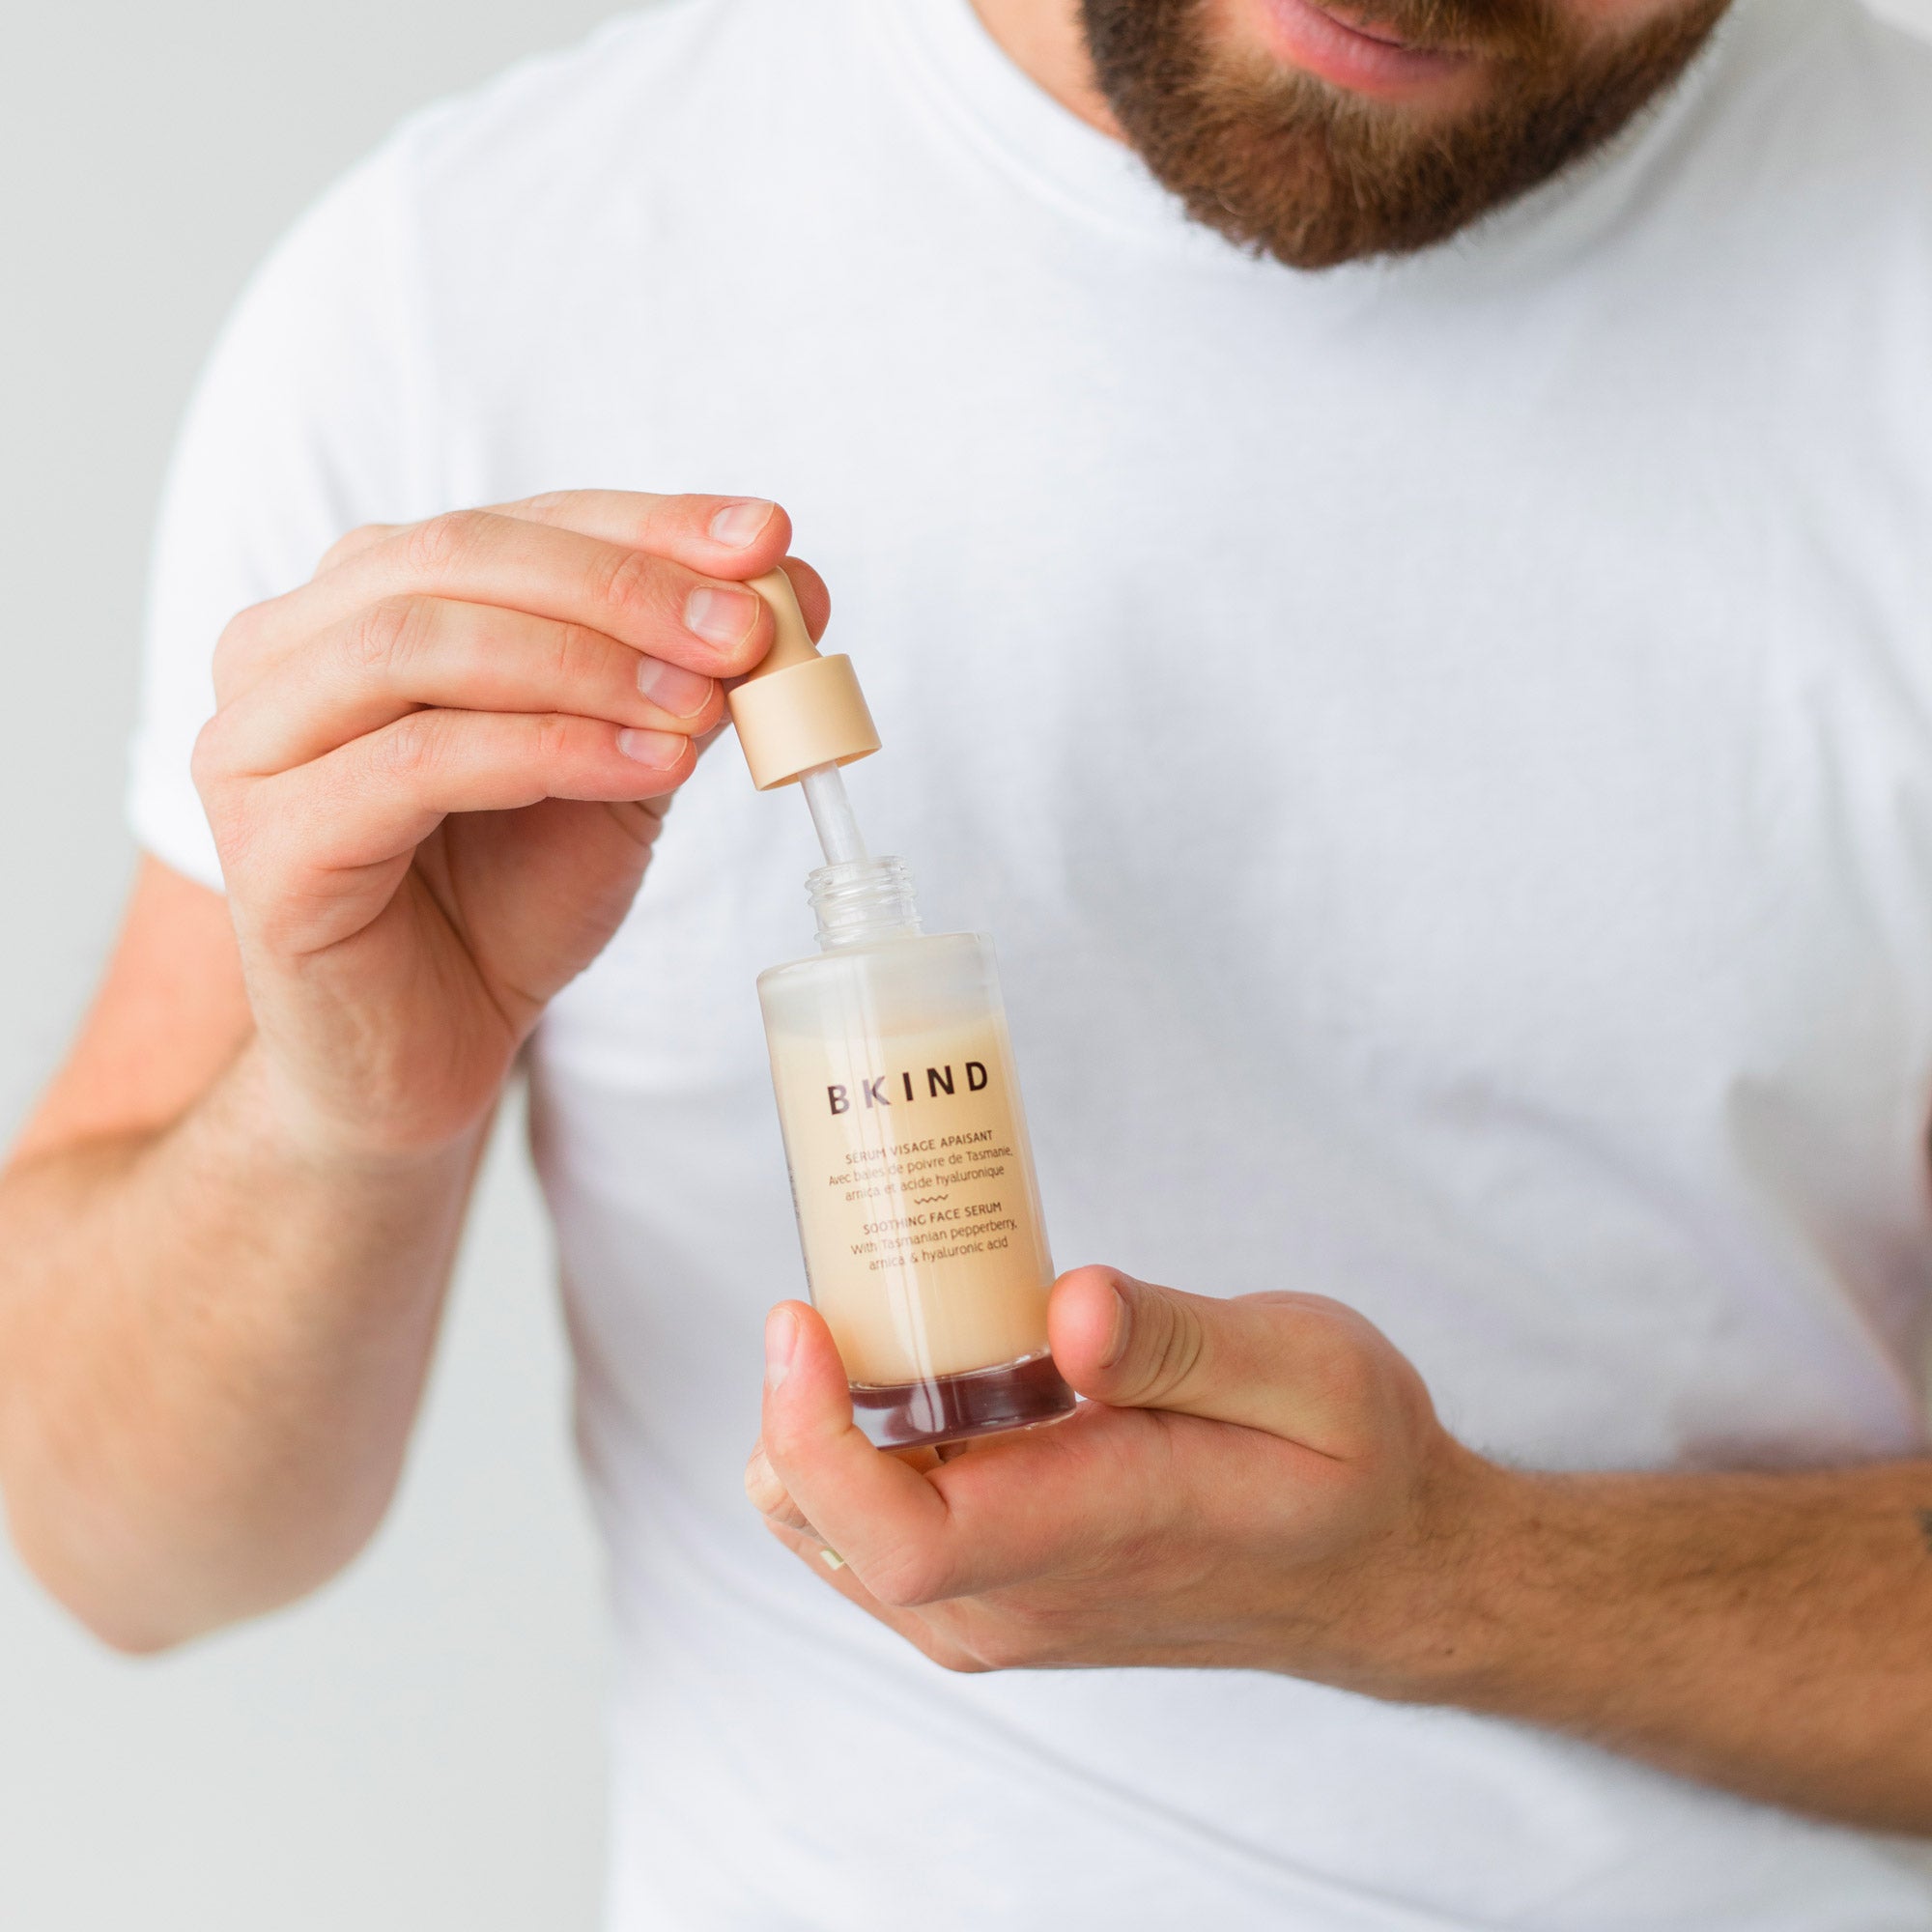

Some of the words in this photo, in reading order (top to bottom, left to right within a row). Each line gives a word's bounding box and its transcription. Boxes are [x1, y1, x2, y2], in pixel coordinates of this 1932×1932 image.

[827, 1061, 988, 1115] BKIND
[890, 1139, 936, 1156] VISAGE
[940, 1129, 993, 1149] APAISANT
[829, 1174, 852, 1186] Avec
[888, 1162, 904, 1176] de
[907, 1156, 946, 1174] poivre
[948, 1152, 964, 1165] de
[899, 1175, 933, 1191] acide
[935, 1165, 1005, 1186] hyaluronique
[863, 1213, 926, 1236] SOOTHING
[929, 1208, 960, 1224] FACE
[964, 1201, 1002, 1217] SERUM
[850, 1240, 878, 1255] With
[879, 1230, 948, 1251] Tasmanian
[868, 1255, 905, 1271] arnica
[911, 1251, 919, 1264] &
[922, 1240, 983, 1264] hyaluronic
[986, 1236, 1009, 1250] acid
